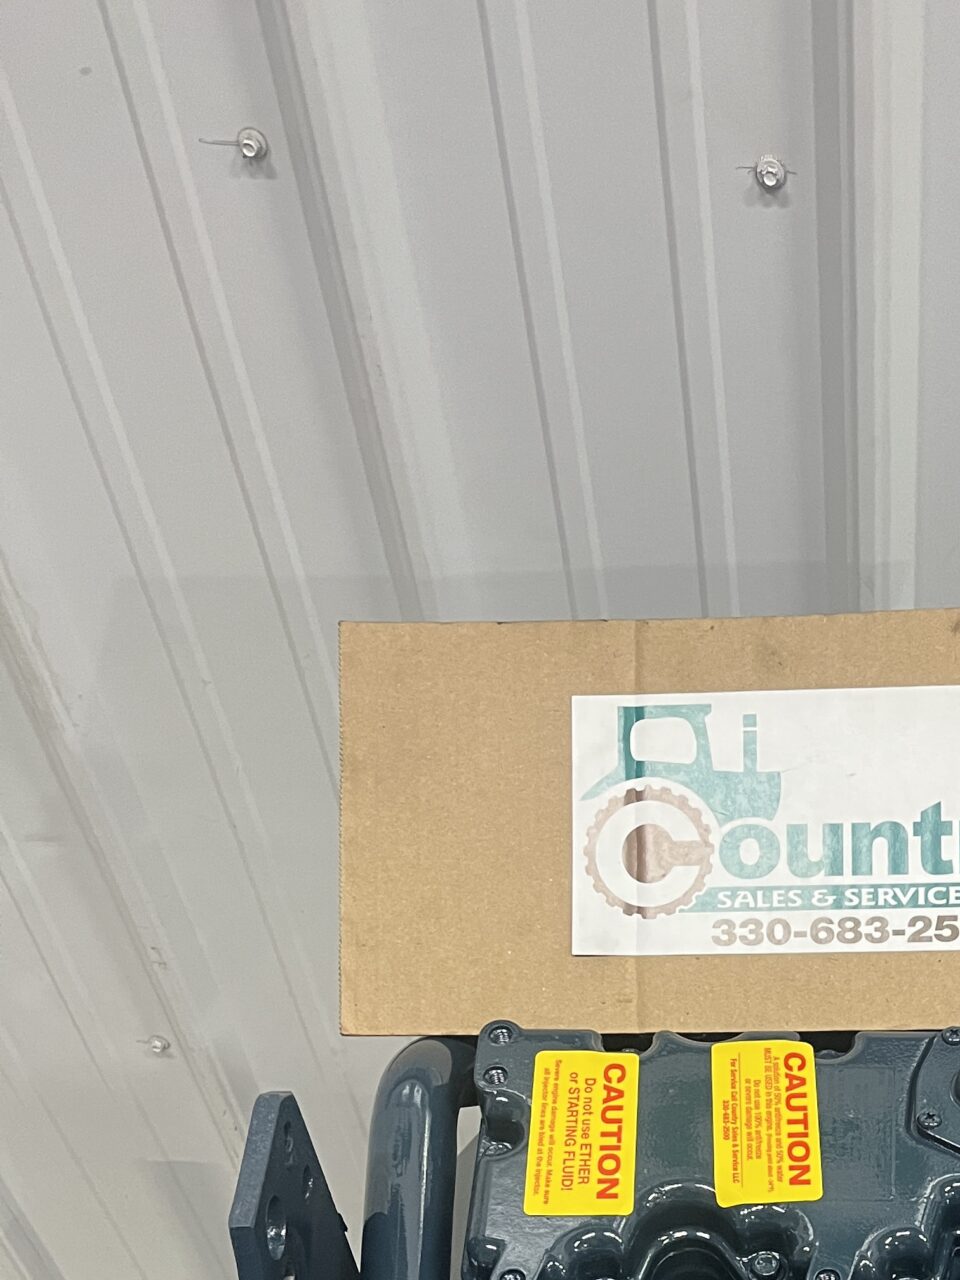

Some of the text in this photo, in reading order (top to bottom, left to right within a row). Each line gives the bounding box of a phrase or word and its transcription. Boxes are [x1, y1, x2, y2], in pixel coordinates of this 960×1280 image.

[717, 889, 802, 909] SALES
[811, 889, 838, 908] &
[549, 1106, 558, 1132] damage
[550, 1083, 560, 1104] engine
[561, 1072, 579, 1191] or STARTING FLUID!
[578, 1078, 596, 1184] Do not use ETHER
[596, 1063, 626, 1199] CAUTION
[784, 1052, 811, 1185] CAUTION
